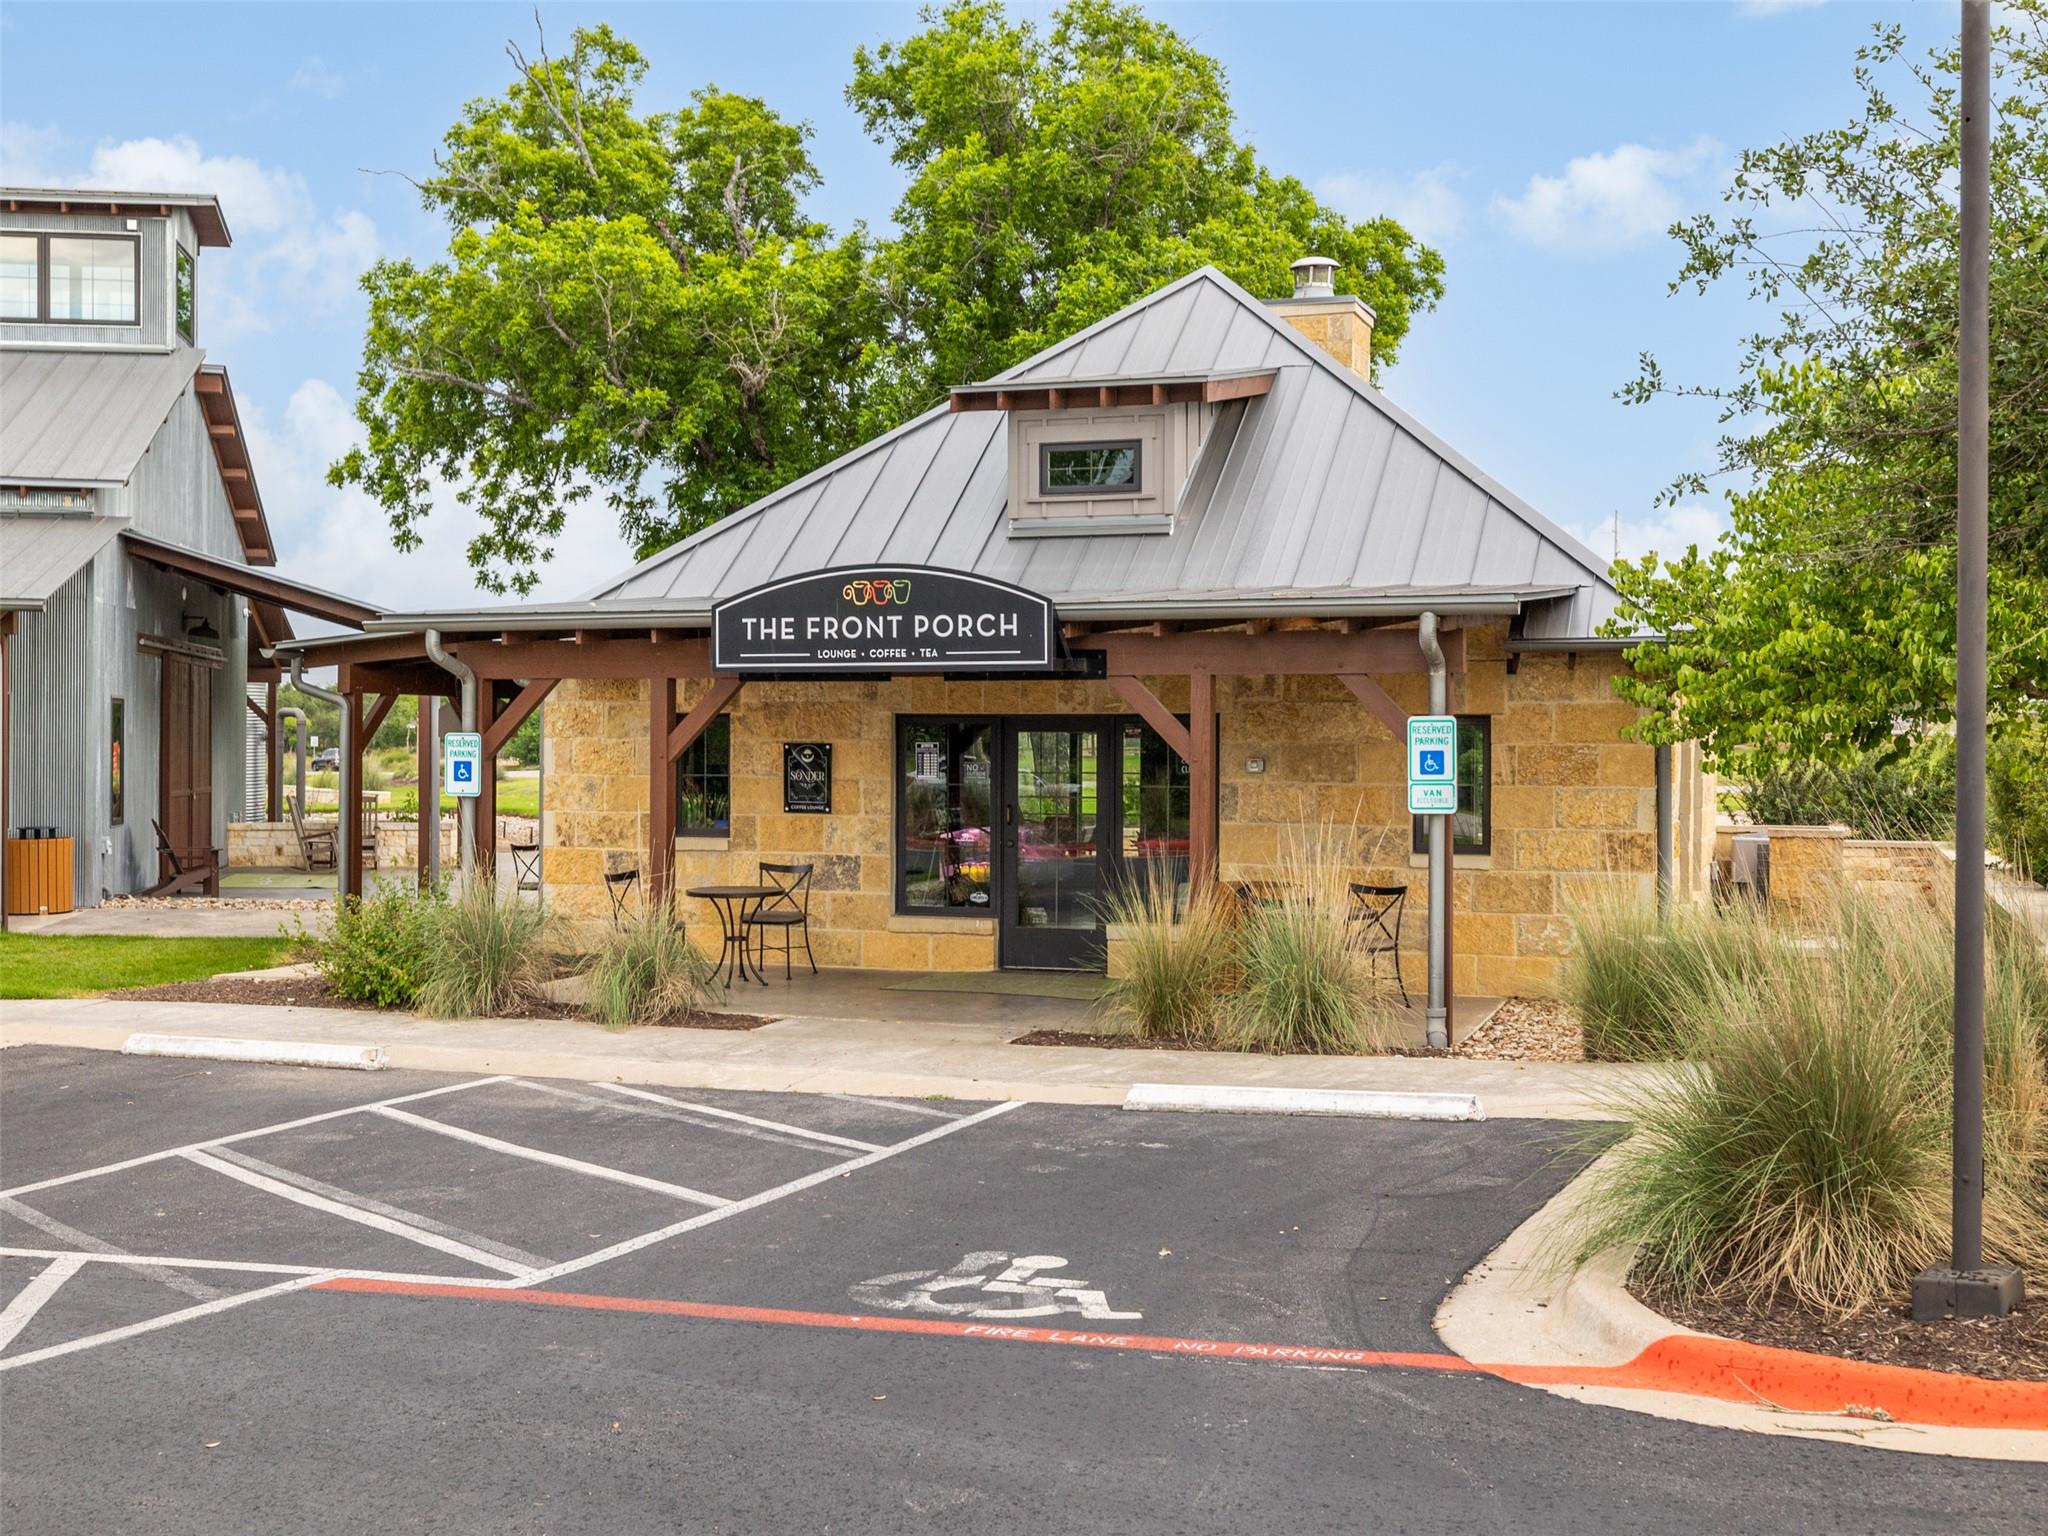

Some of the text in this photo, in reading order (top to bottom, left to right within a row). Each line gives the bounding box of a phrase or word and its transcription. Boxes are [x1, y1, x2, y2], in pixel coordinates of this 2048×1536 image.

[742, 612, 1018, 640] THE FRONT PORCH
[817, 648, 938, 659] LOUNGE COFFEE TEA
[1412, 725, 1452, 735] RESERVED
[1415, 737, 1449, 745] PARKING
[450, 750, 477, 758] PARKING
[790, 769, 824, 781] SONDER
[1423, 789, 1442, 797] VAN
[964, 1325, 1366, 1361] FIRE LANE NO PARKING
